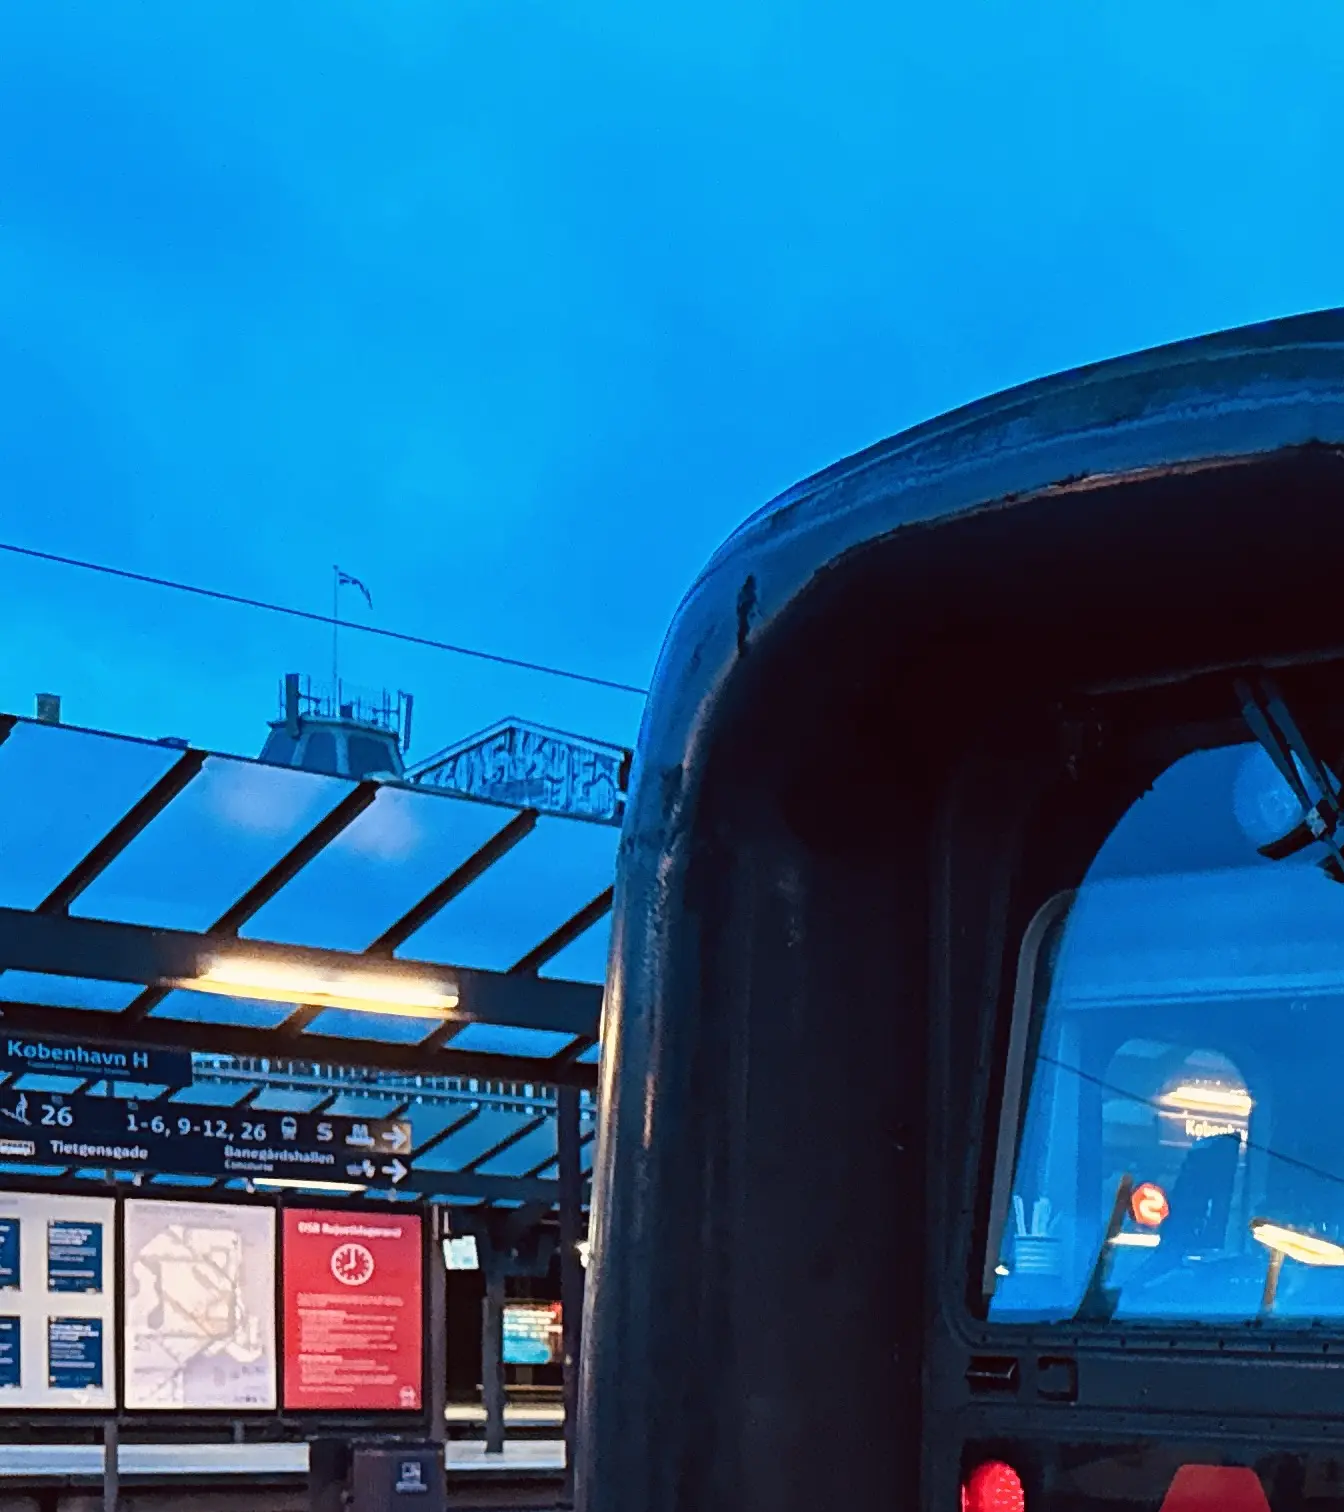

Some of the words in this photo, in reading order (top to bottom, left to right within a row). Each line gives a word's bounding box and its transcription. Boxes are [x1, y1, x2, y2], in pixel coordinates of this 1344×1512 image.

[133, 1051, 149, 1069] H
[41, 1104, 73, 1127] 26
[127, 1114, 172, 1138] 1-6,
[177, 1117, 235, 1141] 9-12,
[241, 1121, 267, 1142] 26
